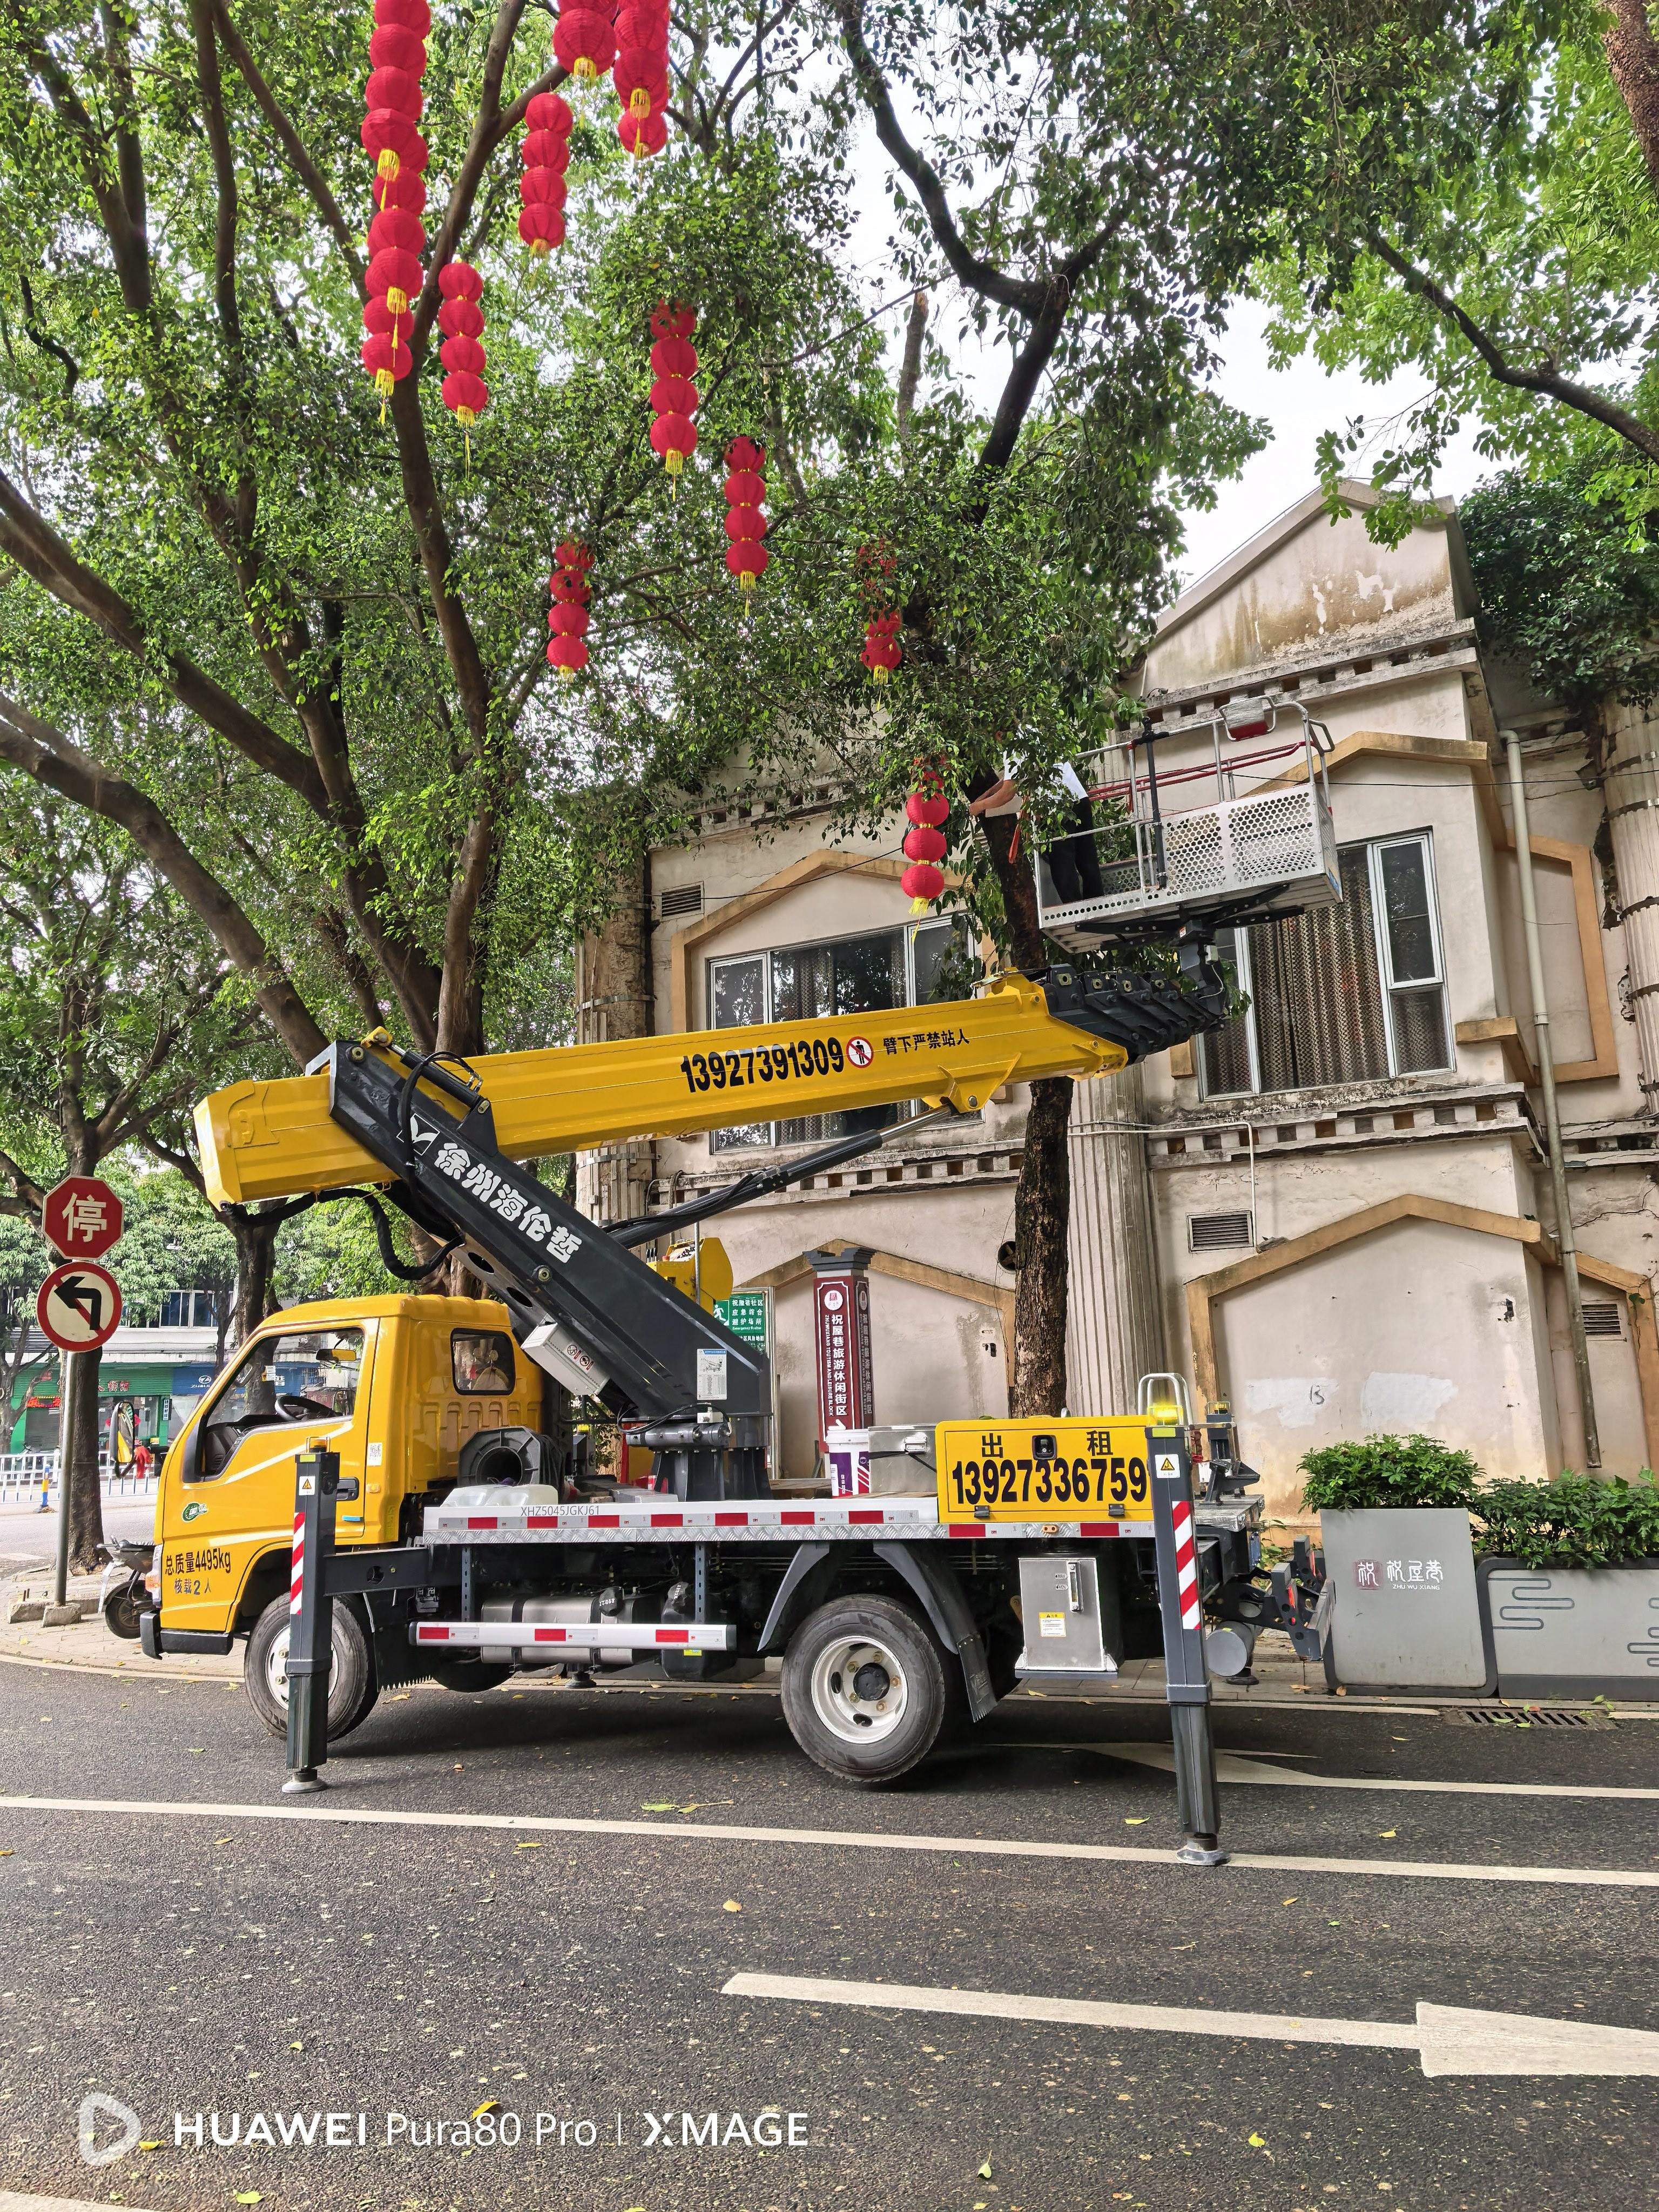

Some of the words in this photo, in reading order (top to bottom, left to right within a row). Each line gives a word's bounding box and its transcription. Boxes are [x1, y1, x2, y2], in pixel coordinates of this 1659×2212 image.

[882, 1028, 969, 1055] 臂下严禁站人
[680, 1037, 844, 1093] 13927391309
[62, 1192, 107, 1242] 停
[434, 1143, 582, 1263] 徐州海伦哲
[832, 1314, 847, 1415] 祝屋巷旅游休闲街区
[952, 1457, 1147, 1505] 13927336759
[521, 1505, 599, 1516] XHZ5045JGKJ61
[165, 1548, 231, 1575] 总质量4495kg
[1386, 1560, 1443, 1583] 祝屋巷
[174, 1577, 211, 1595] 核载2人
